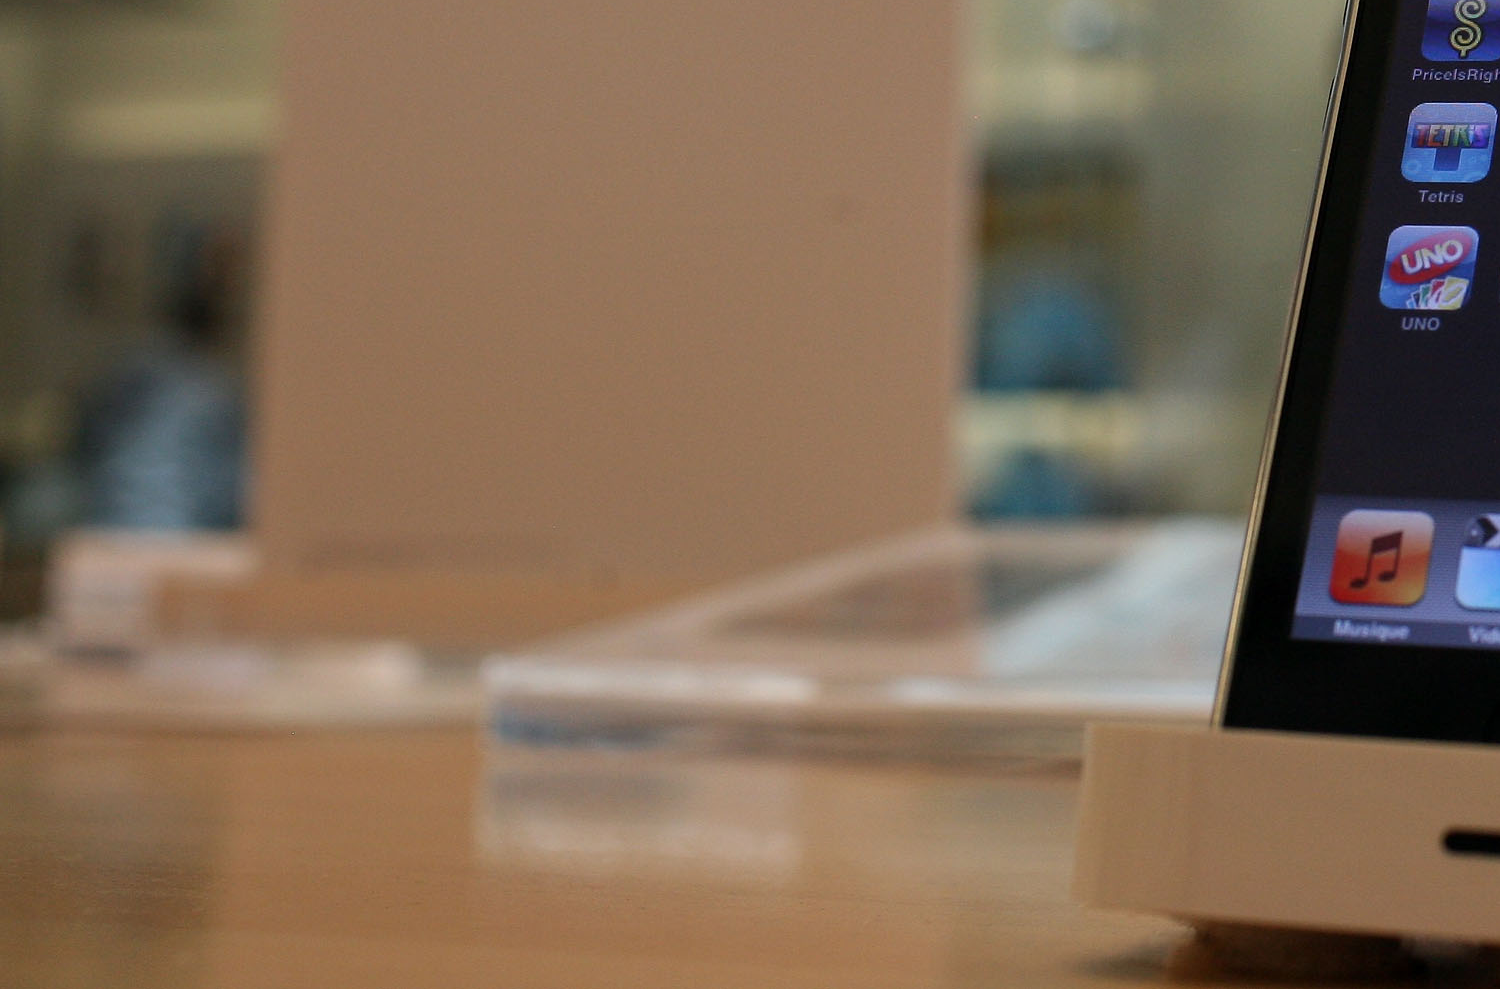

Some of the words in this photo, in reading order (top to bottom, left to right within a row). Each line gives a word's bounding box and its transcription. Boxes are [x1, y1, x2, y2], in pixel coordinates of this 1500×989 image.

[1419, 189, 1464, 203] Tetris
[1401, 239, 1464, 275] UNO
[1401, 317, 1440, 331] UNO
[1333, 619, 1411, 642] Musique
